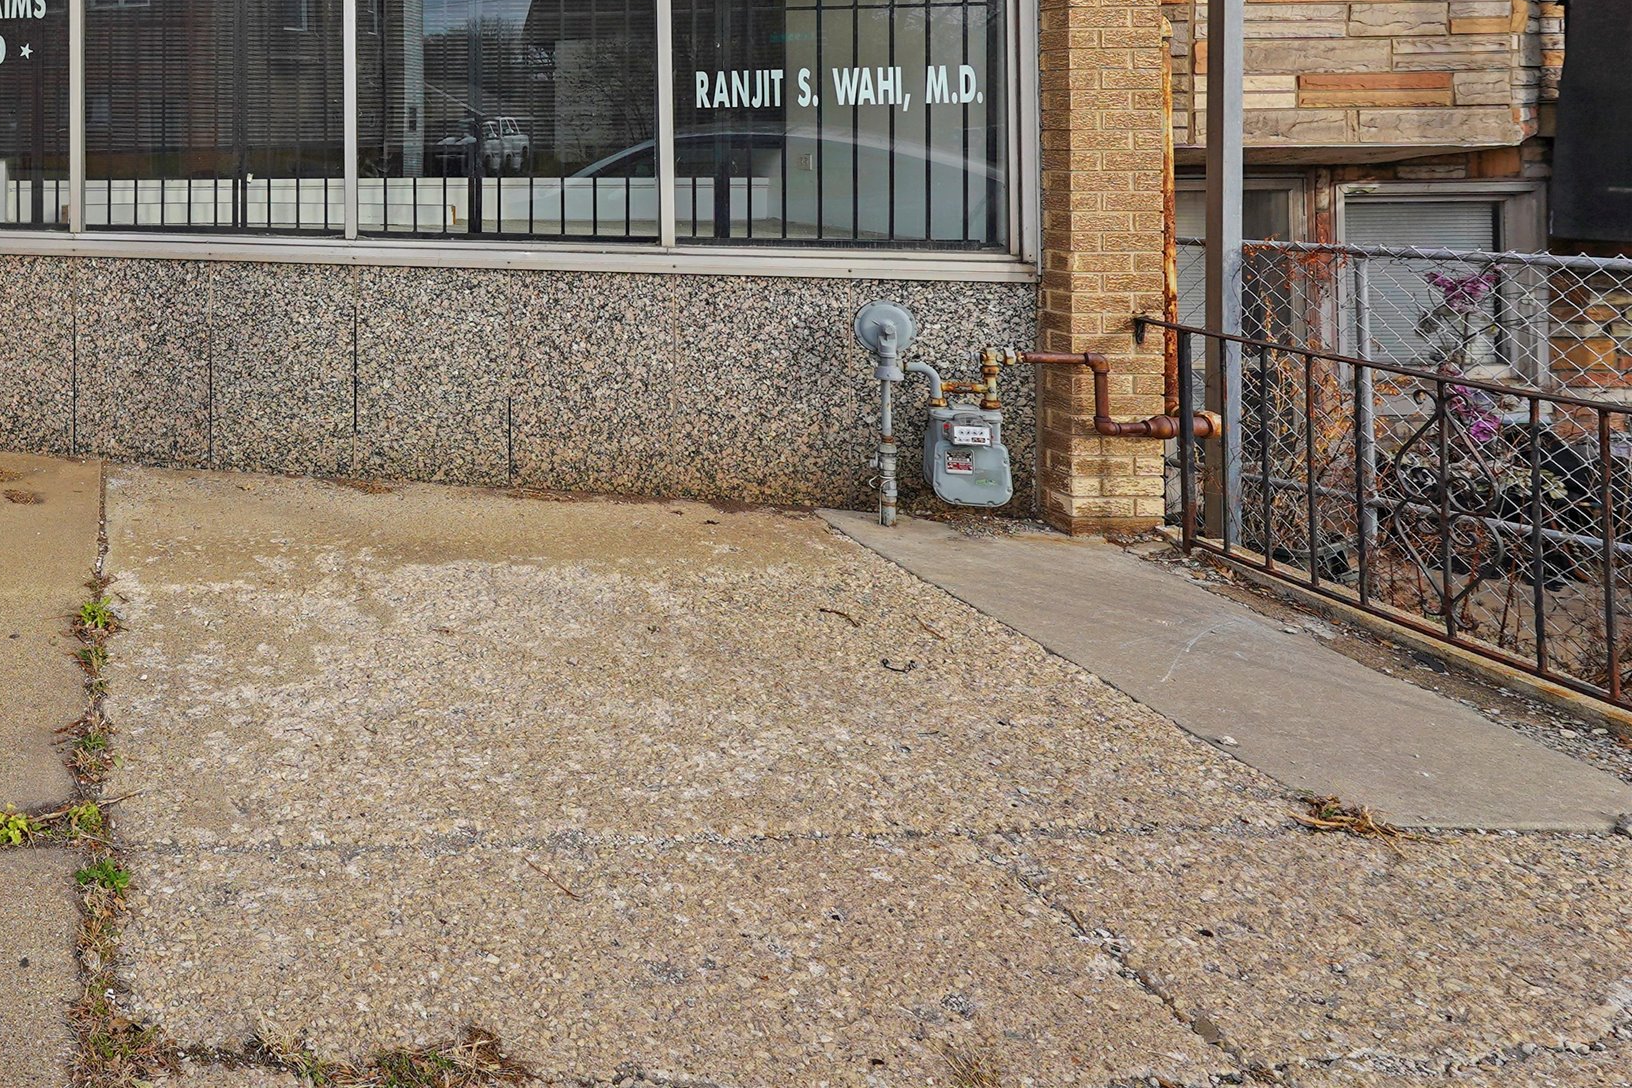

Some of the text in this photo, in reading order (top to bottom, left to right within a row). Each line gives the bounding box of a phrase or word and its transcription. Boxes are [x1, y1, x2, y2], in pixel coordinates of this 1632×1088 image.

[695, 64, 984, 112] RANJIT S. WAHI, M.D.
